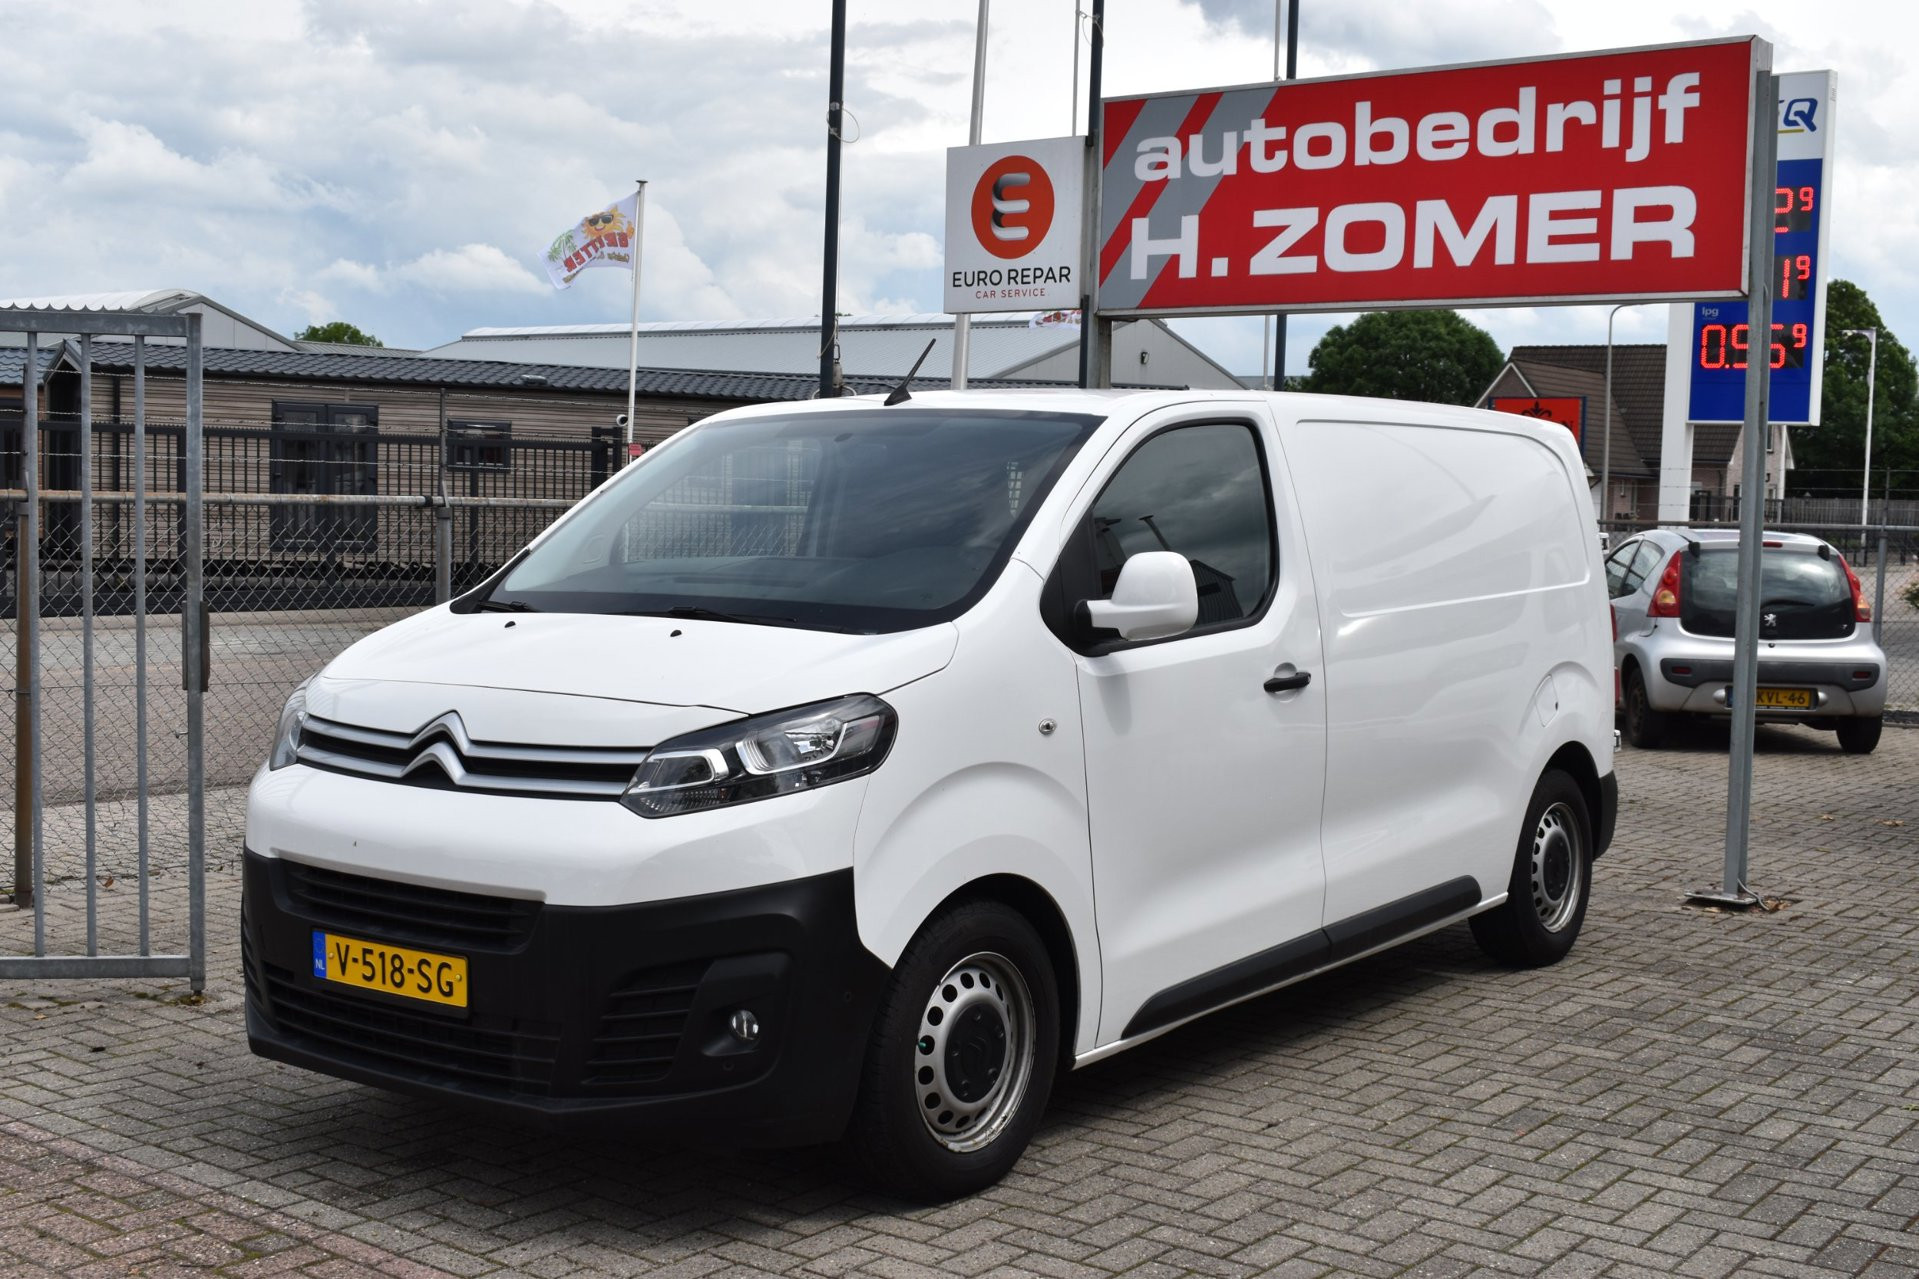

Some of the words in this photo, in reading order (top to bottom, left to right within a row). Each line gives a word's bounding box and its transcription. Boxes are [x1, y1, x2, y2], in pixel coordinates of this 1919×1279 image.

[1133, 72, 1700, 183] autobedrijf
[1779, 97, 1818, 132] Q
[1130, 213, 1229, 280] H.
[1249, 185, 1698, 276] ZOMER
[952, 269, 1003, 288] EURO
[1007, 265, 1071, 286] REPAR
[975, 289, 996, 300] CAR
[1001, 287, 1046, 299] SERVICE
[1701, 306, 1719, 317] lpg
[315, 957, 326, 970] NL
[335, 941, 454, 998] V-518-SG
